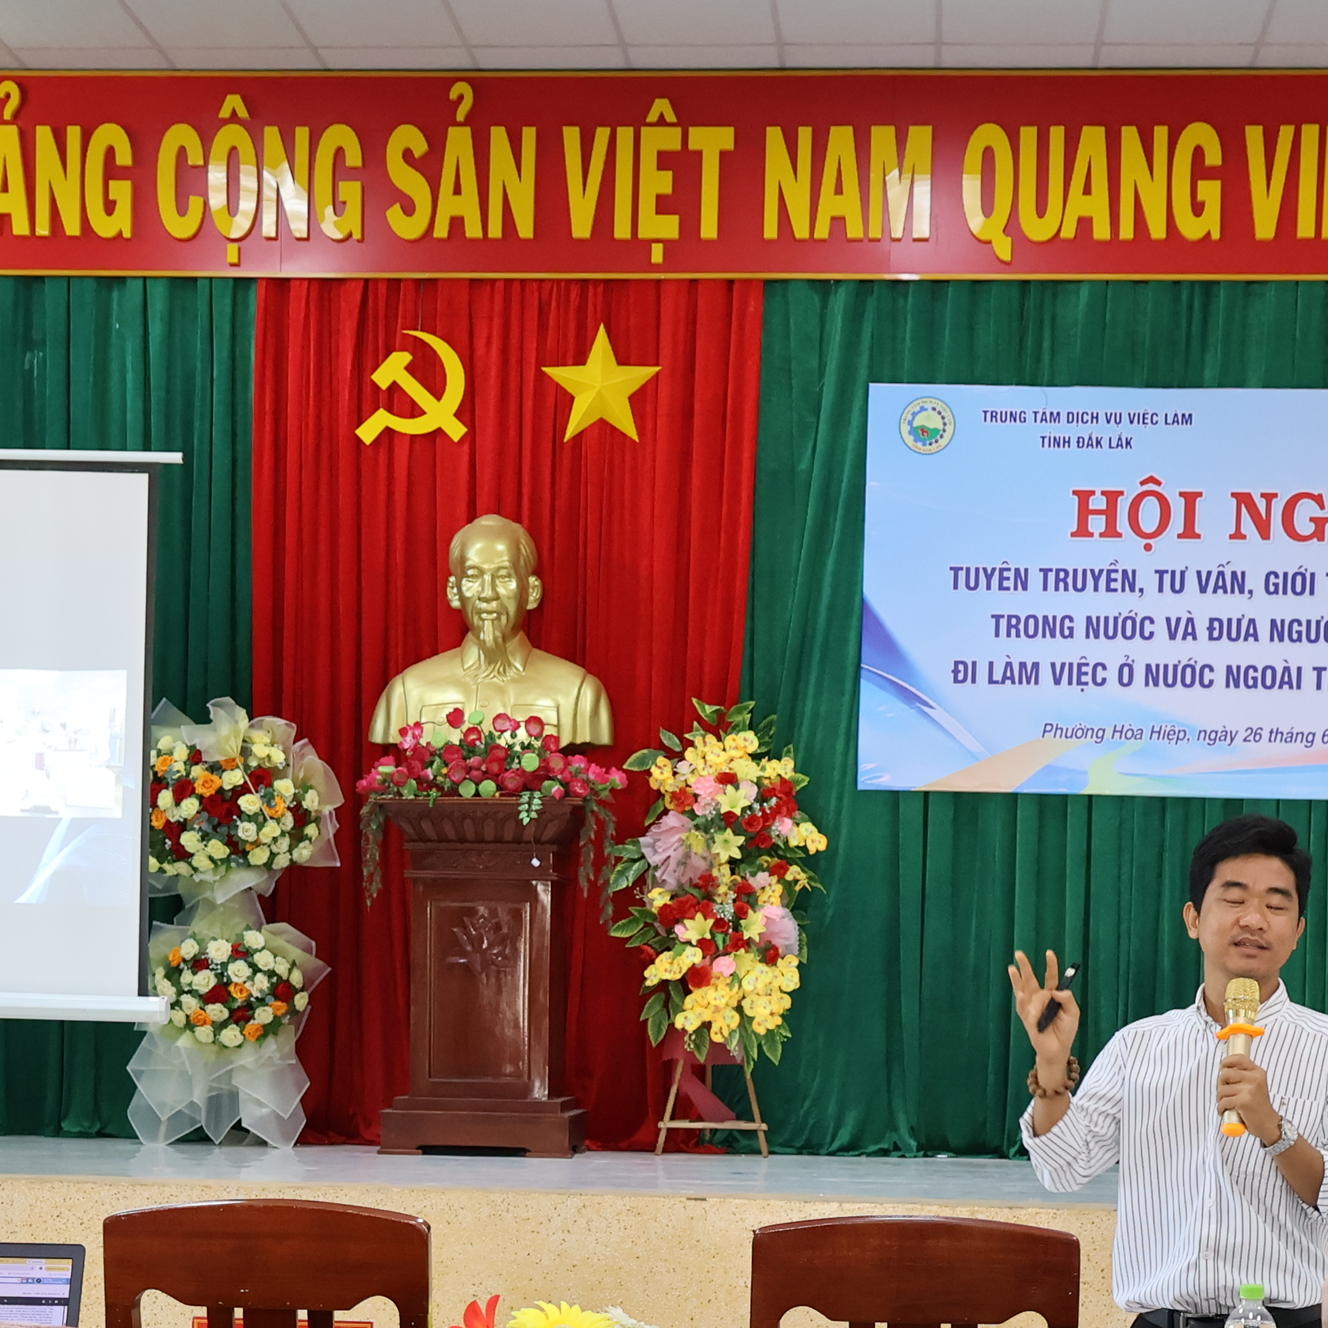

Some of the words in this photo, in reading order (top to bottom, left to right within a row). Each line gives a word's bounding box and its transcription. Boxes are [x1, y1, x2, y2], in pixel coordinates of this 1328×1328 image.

[157, 95, 362, 263] CỘNG
[386, 82, 536, 240] SẢN
[563, 99, 734, 263] VIỆT
[764, 126, 932, 239] NAM
[963, 122, 1222, 261] QUANG
[982, 410, 1026, 423] TRUNG
[1033, 411, 1060, 423] TÂM
[1067, 412, 1099, 427] DỊCH
[1105, 412, 1122, 425] VỤ
[1128, 412, 1158, 428] VIỆC
[1165, 413, 1192, 425] LÀM
[1040, 436, 1070, 448] TỈNH
[1076, 435, 1103, 448] ĐẮK
[1109, 435, 1132, 449] LẮK
[1071, 476, 1203, 551] HỘI
[950, 561, 1028, 591] TUYÊN
[1039, 560, 1144, 597] TRUYỀN,
[1155, 566, 1188, 594] TƯ
[1196, 561, 1253, 599] VẤN,
[1264, 566, 1315, 596] GIỚI
[991, 614, 1074, 639] TRONG
[1085, 610, 1155, 640] NƯỚC
[1165, 611, 1197, 641] VÀ
[1207, 614, 1259, 642] ĐƯA
[951, 660, 977, 684] ĐI
[988, 655, 1039, 685] LÀM
[1050, 656, 1107, 692] VIỆC
[1118, 655, 1134, 687] Ở
[1145, 658, 1214, 688] NƯỚC
[1225, 660, 1302, 690] NGOÀI
[1042, 723, 1105, 743] Phường
[1112, 724, 1143, 740] Hòa
[1149, 725, 1189, 745] Hiệp,
[1197, 726, 1238, 746] ngày
[1243, 727, 1263, 743] 26
[1269, 727, 1316, 748] tháng
